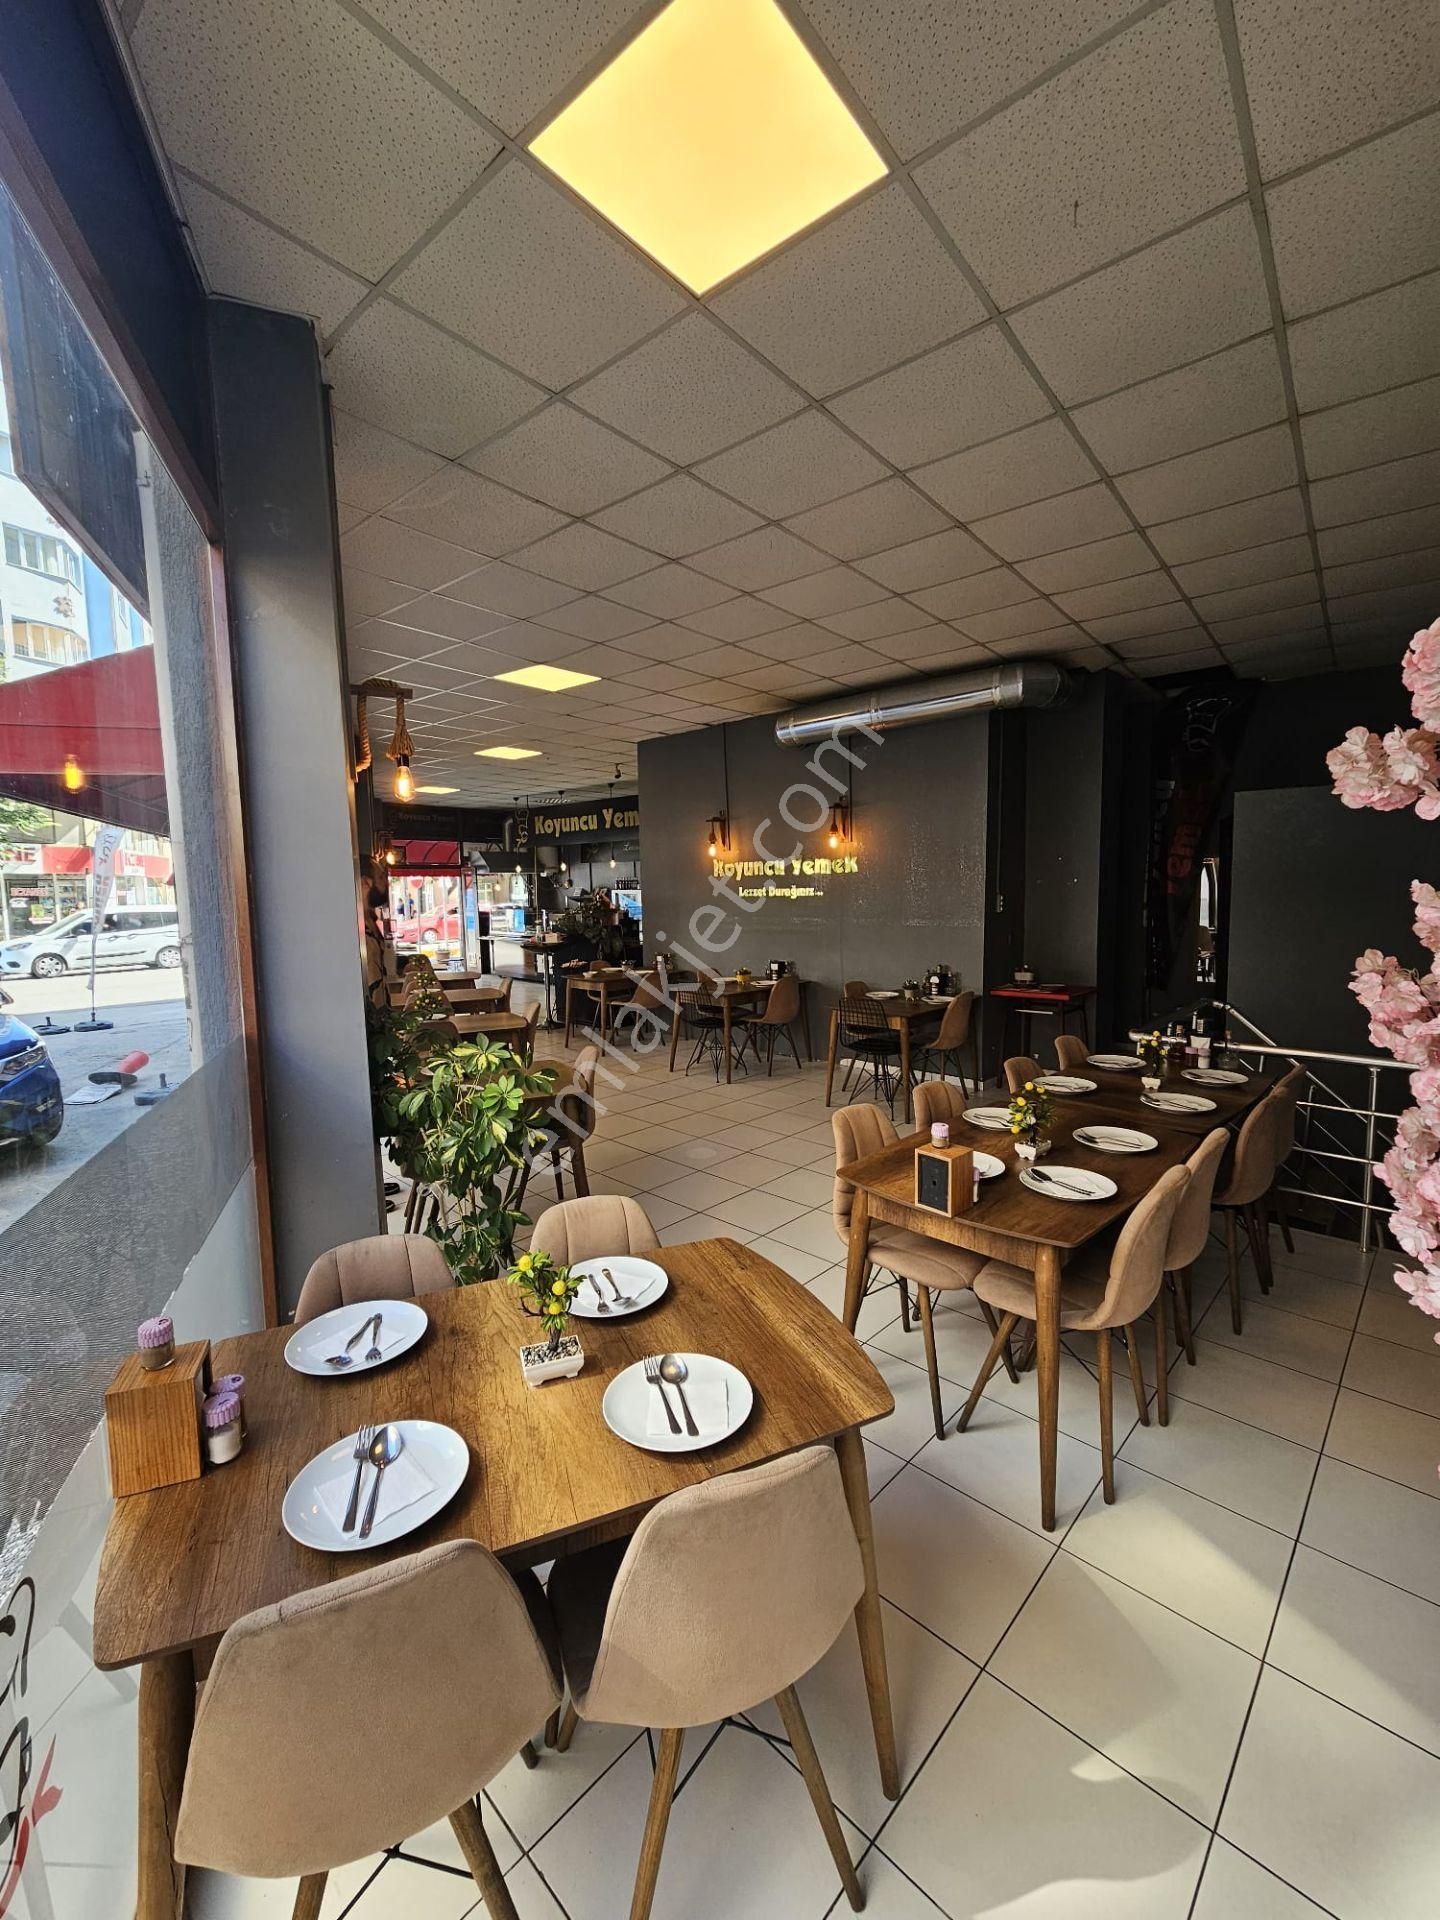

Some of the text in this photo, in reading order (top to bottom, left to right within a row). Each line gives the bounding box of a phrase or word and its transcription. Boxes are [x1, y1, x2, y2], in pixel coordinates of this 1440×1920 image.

[534, 814, 598, 838] Koyuncu
[712, 856, 859, 881] Koyuncu Yemek
[738, 886, 767, 897] Lezzet
